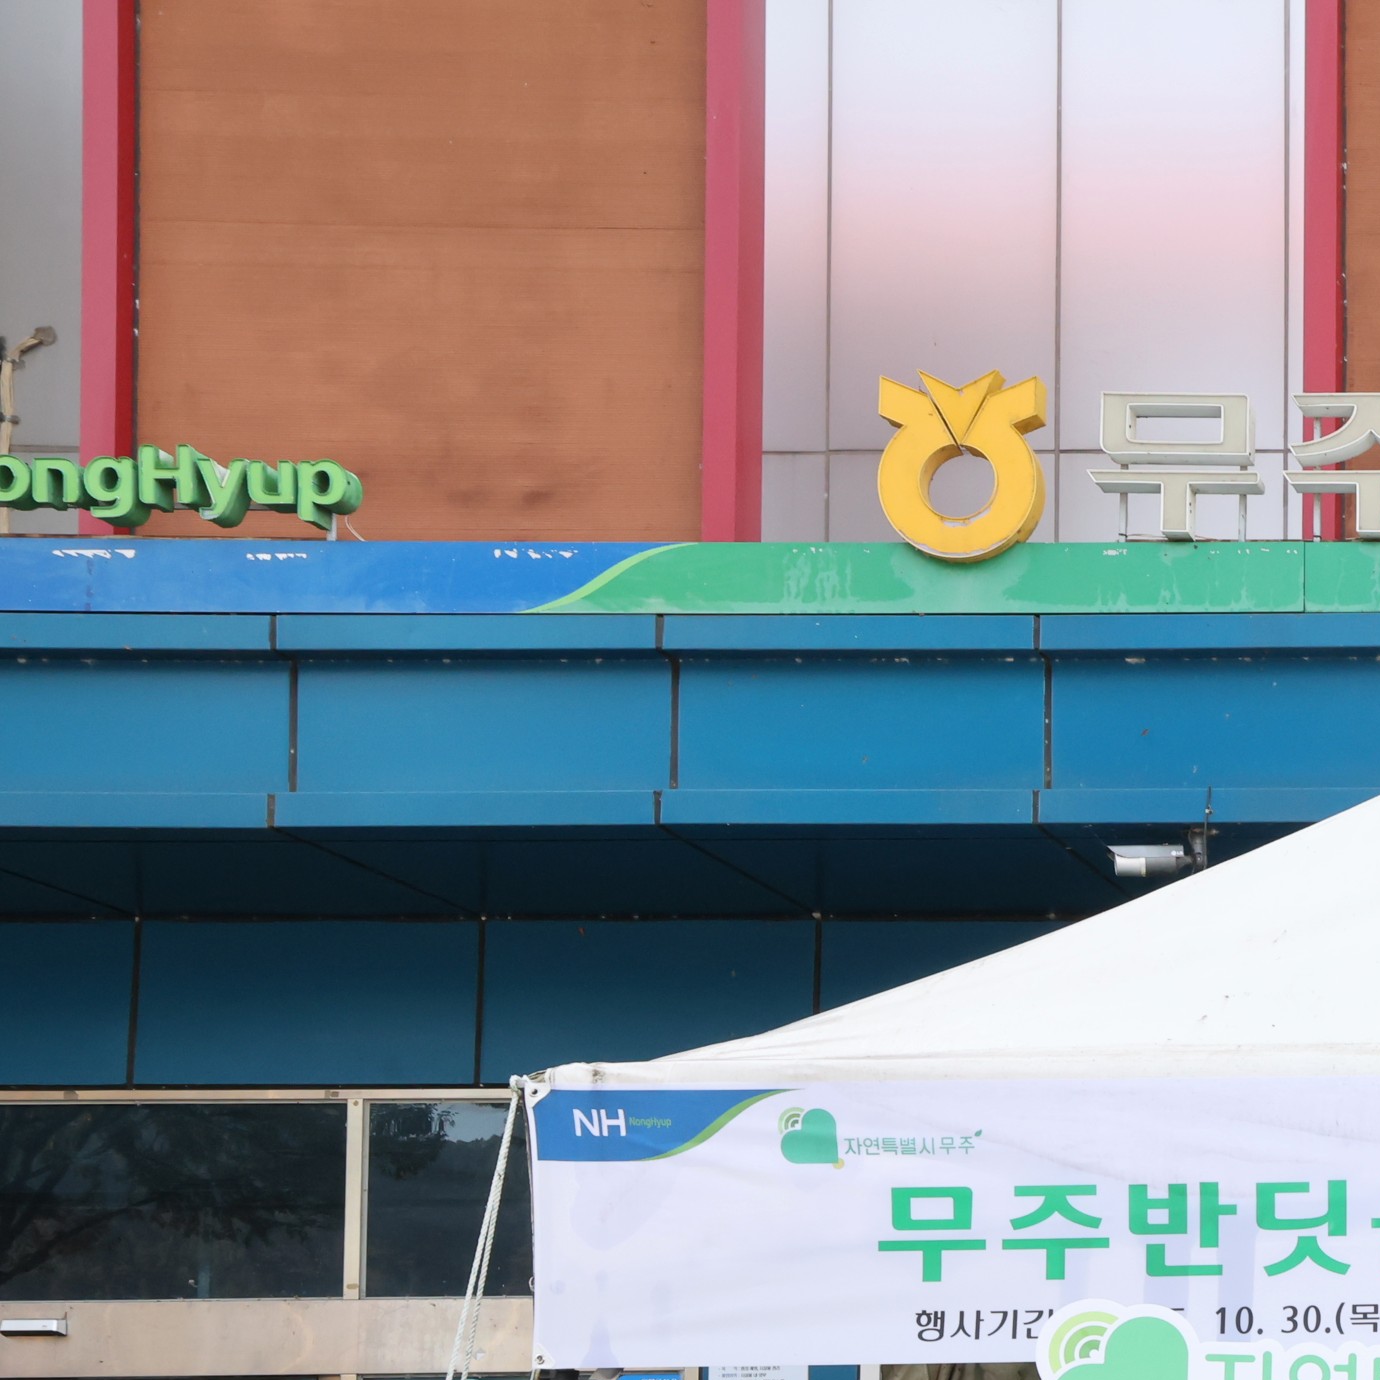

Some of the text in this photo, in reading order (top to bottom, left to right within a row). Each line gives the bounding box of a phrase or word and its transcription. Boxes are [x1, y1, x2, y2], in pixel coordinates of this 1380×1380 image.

[573, 1109, 626, 1138] NH
[844, 1134, 976, 1156] 자연특별시무주
[1214, 1304, 1264, 1335] 10.
